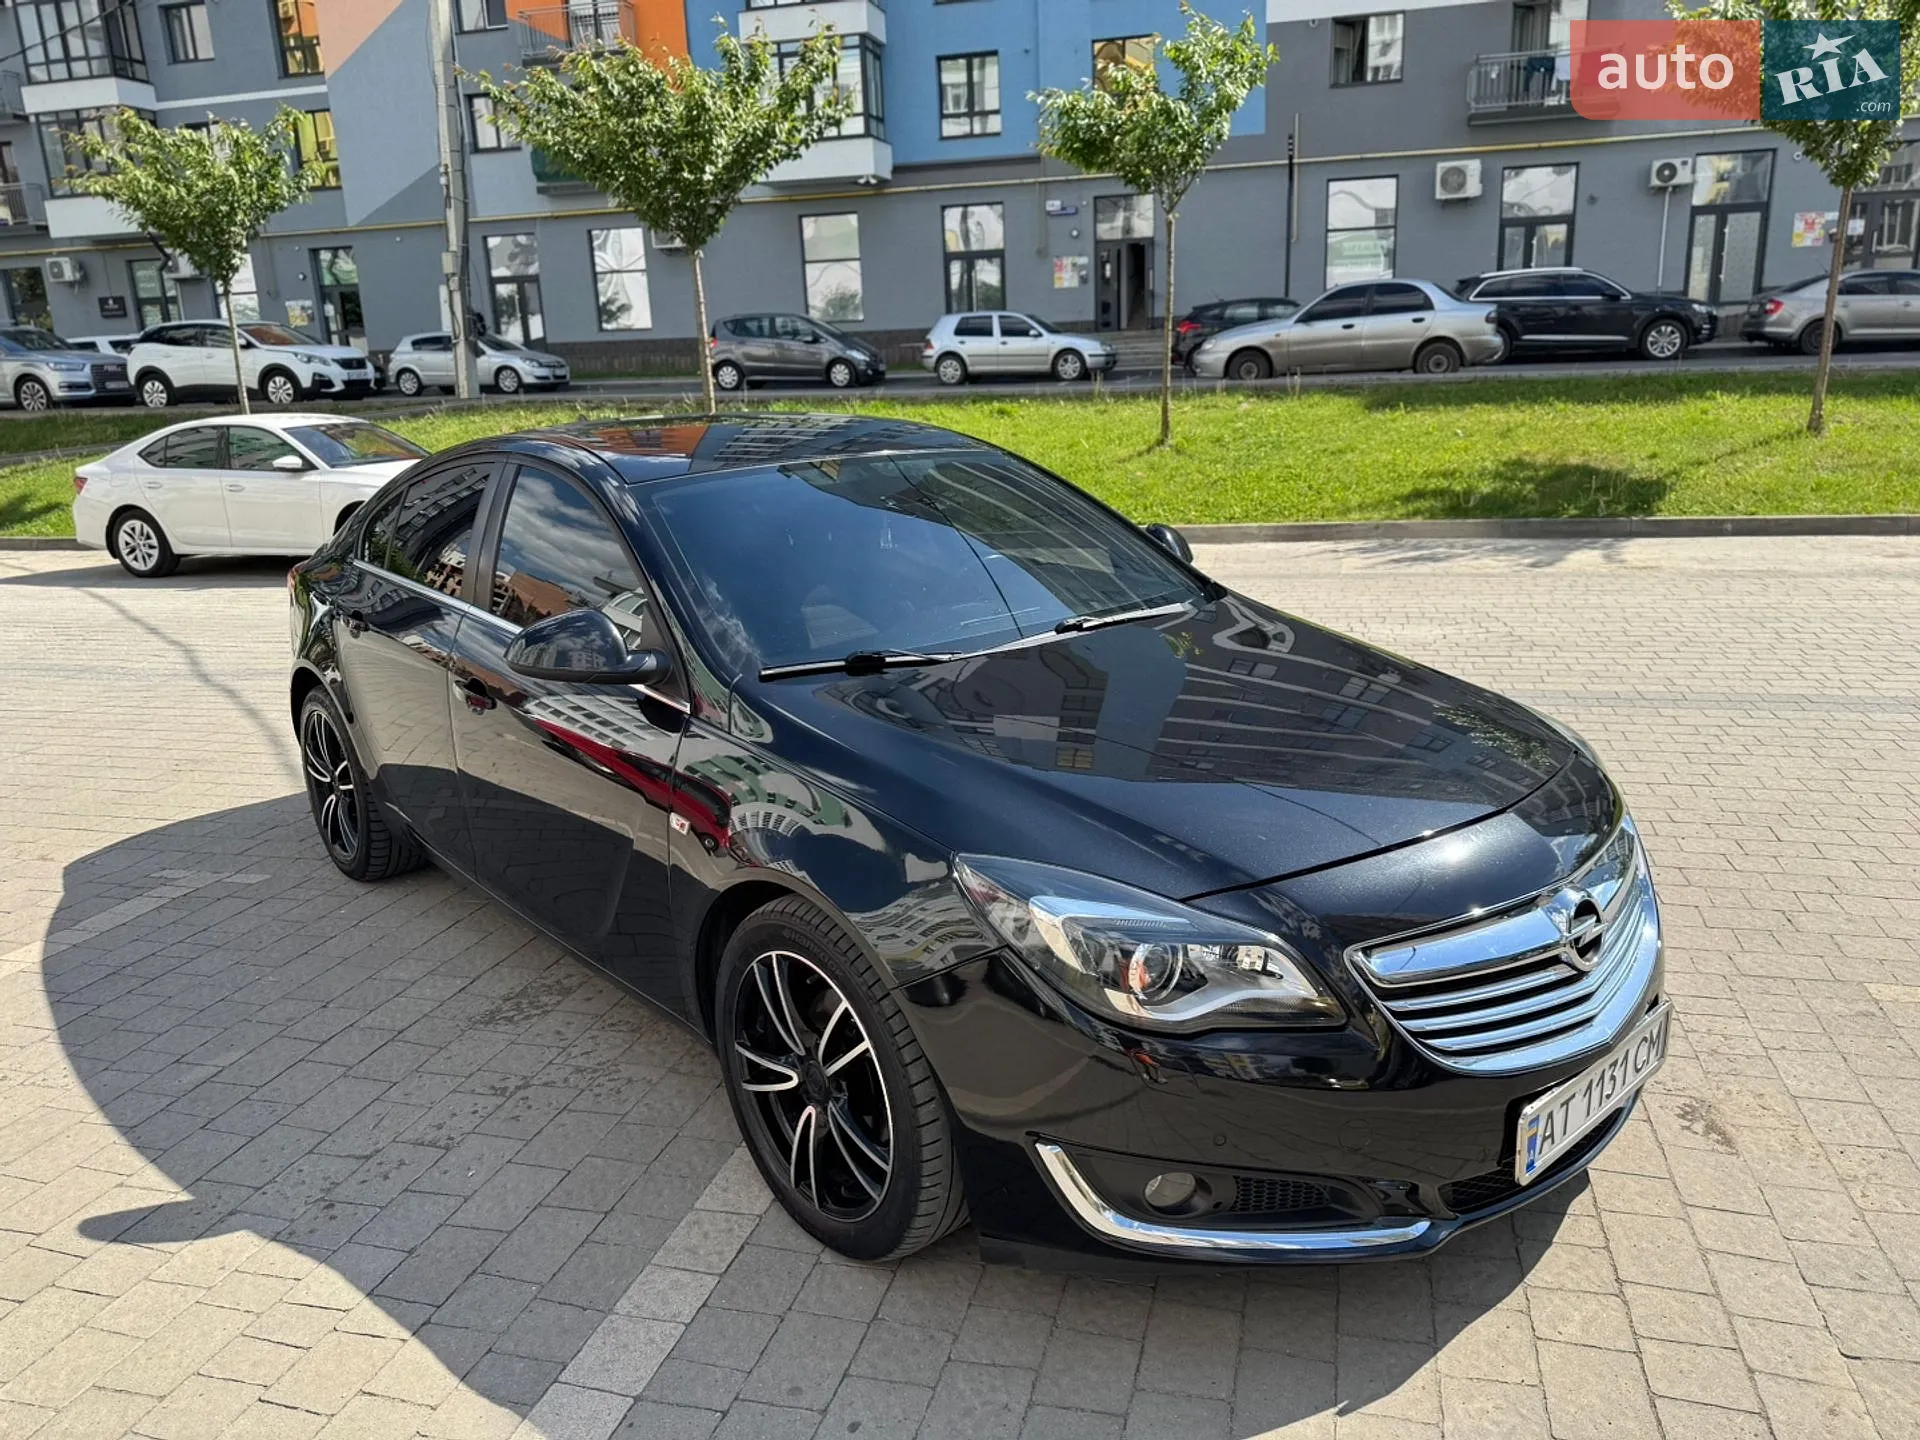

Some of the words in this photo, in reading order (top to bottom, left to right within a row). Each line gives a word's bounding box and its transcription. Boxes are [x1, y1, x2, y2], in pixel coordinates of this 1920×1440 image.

[1539, 1092, 1576, 1155] AT
[1583, 1049, 1630, 1118] 1131
[1634, 1020, 1663, 1073] CM
